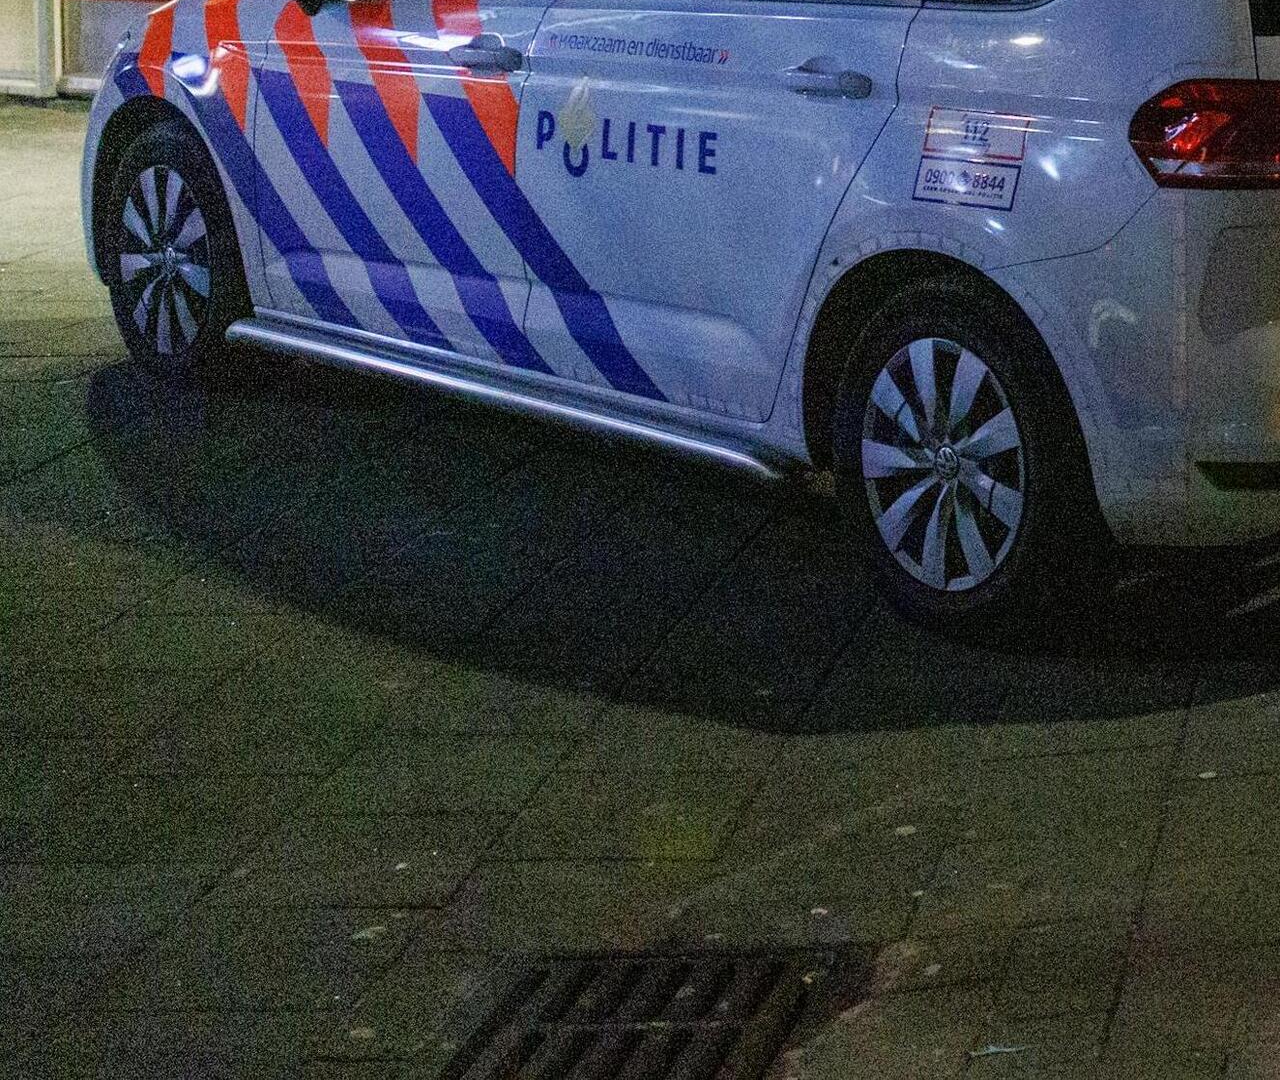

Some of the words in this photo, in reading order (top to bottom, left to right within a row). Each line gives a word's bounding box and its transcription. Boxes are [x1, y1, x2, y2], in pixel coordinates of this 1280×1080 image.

[627, 39, 645, 56] en
[646, 38, 718, 64] dienstbaar
[536, 110, 718, 177] POLITIE
